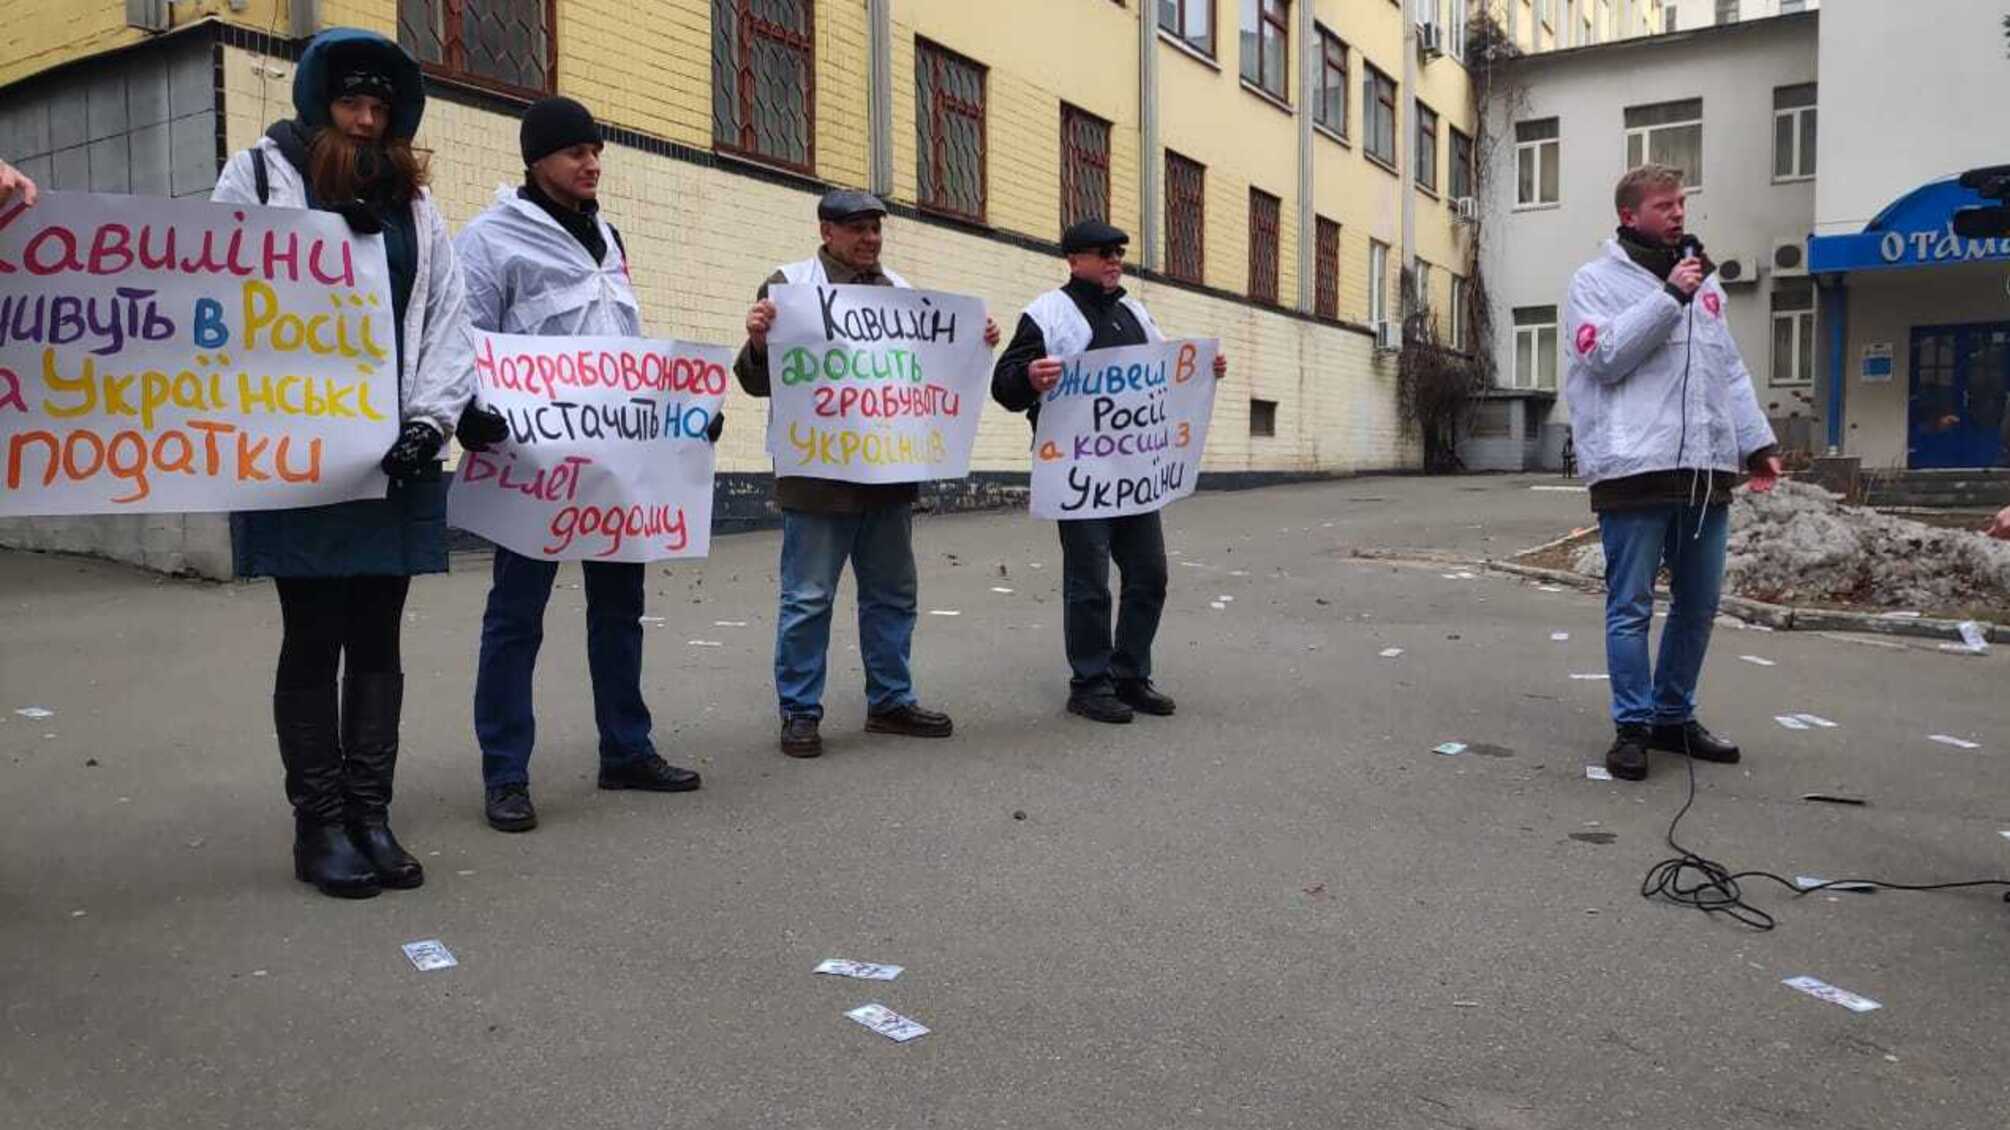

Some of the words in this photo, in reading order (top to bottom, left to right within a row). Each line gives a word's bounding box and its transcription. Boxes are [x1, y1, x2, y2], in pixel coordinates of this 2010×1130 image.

[1880, 221, 2010, 261] Отам
[0, 287, 176, 355] ивуть
[241, 280, 389, 363] Росії
[817, 285, 956, 343] Кавилін
[43, 347, 389, 430] Українські
[1093, 387, 1168, 432] Росії
[488, 398, 659, 444] истачить
[7, 420, 321, 503] податки
[1061, 456, 1185, 511] України
[544, 504, 687, 557] додому
